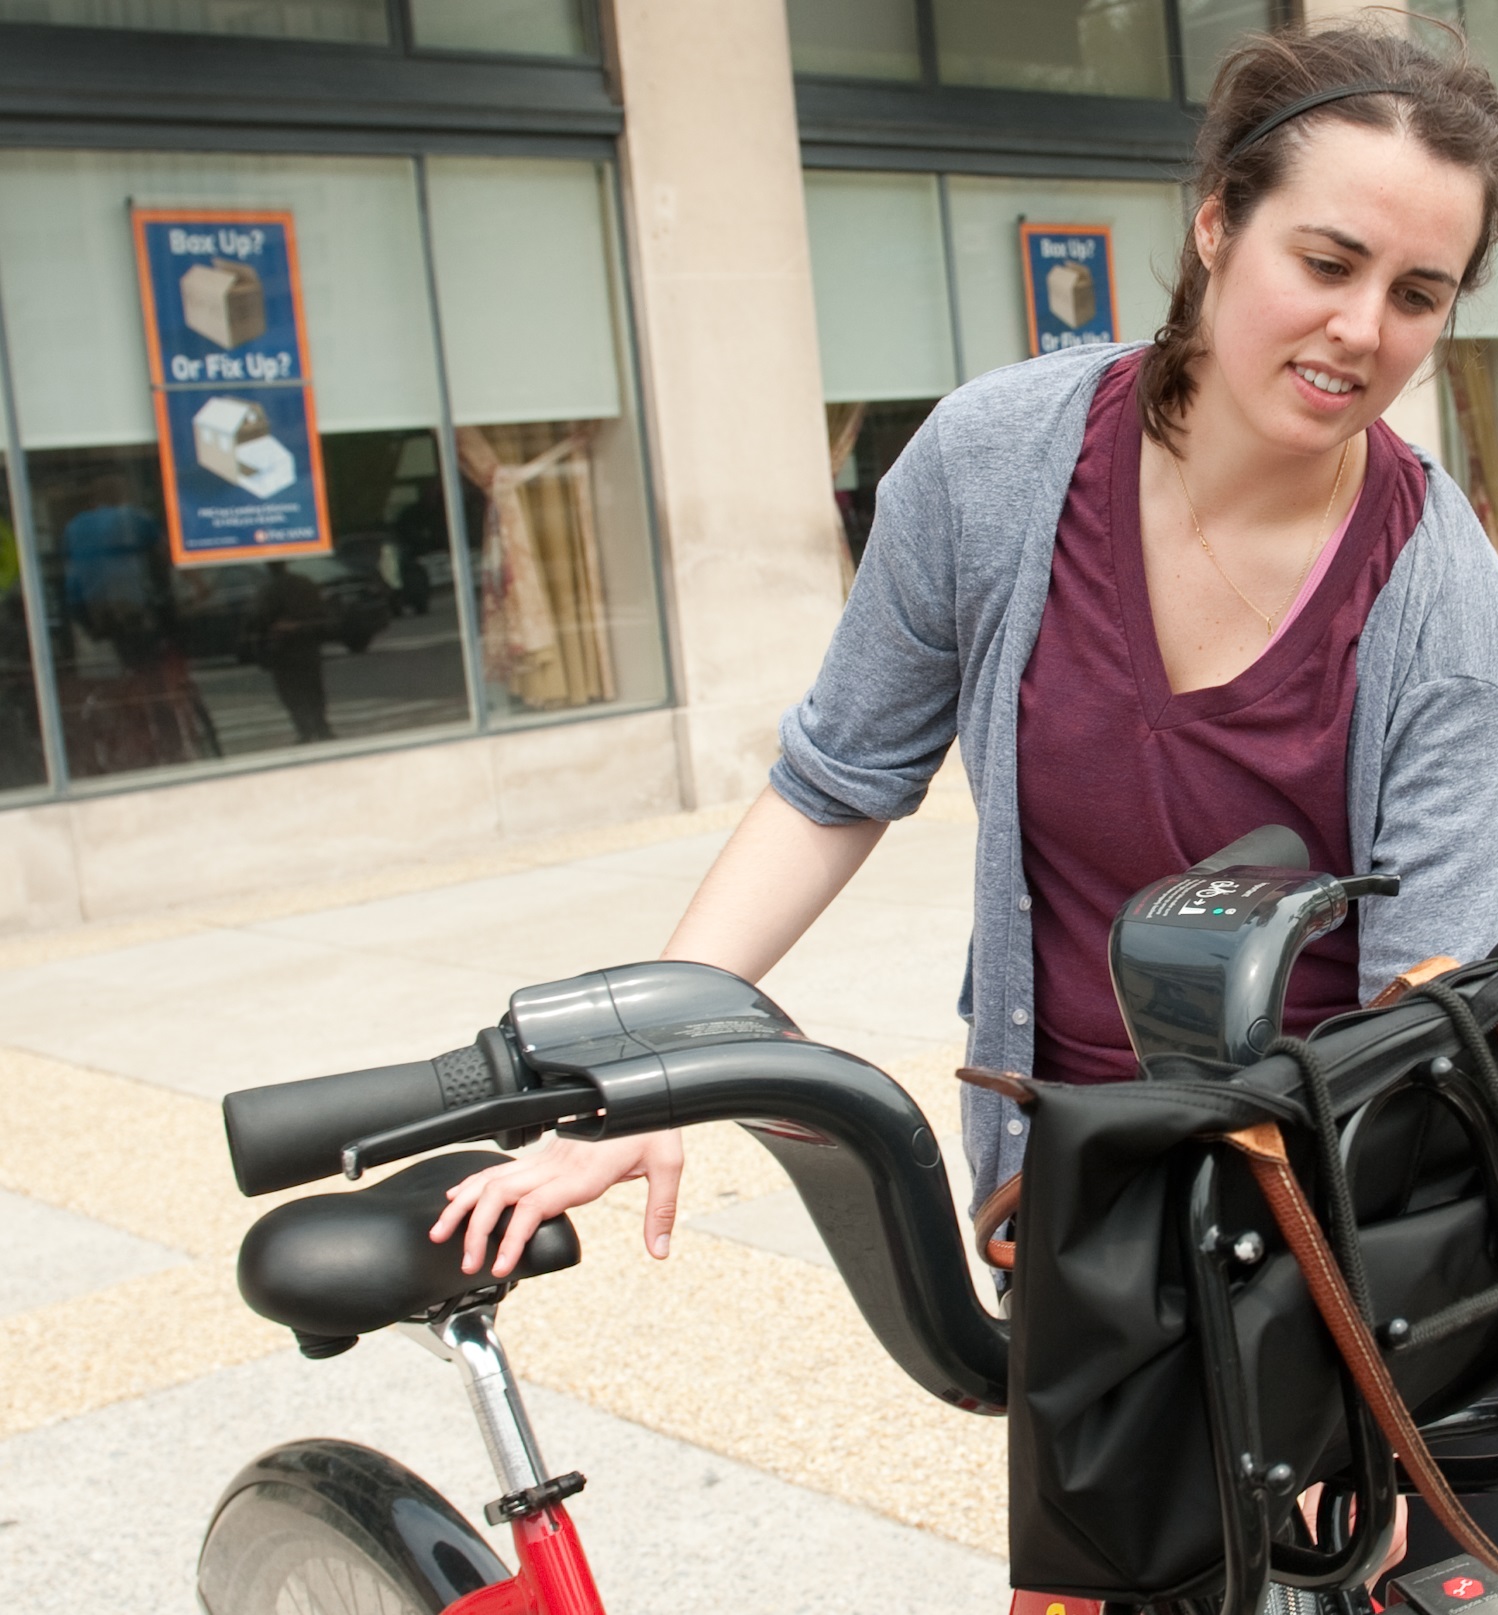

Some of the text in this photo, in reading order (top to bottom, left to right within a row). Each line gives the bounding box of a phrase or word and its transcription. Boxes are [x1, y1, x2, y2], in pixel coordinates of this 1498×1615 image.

[169, 228, 266, 259] Box Up?
[1040, 237, 1096, 262] Box Up?
[171, 351, 292, 384] Or Fix Up?
